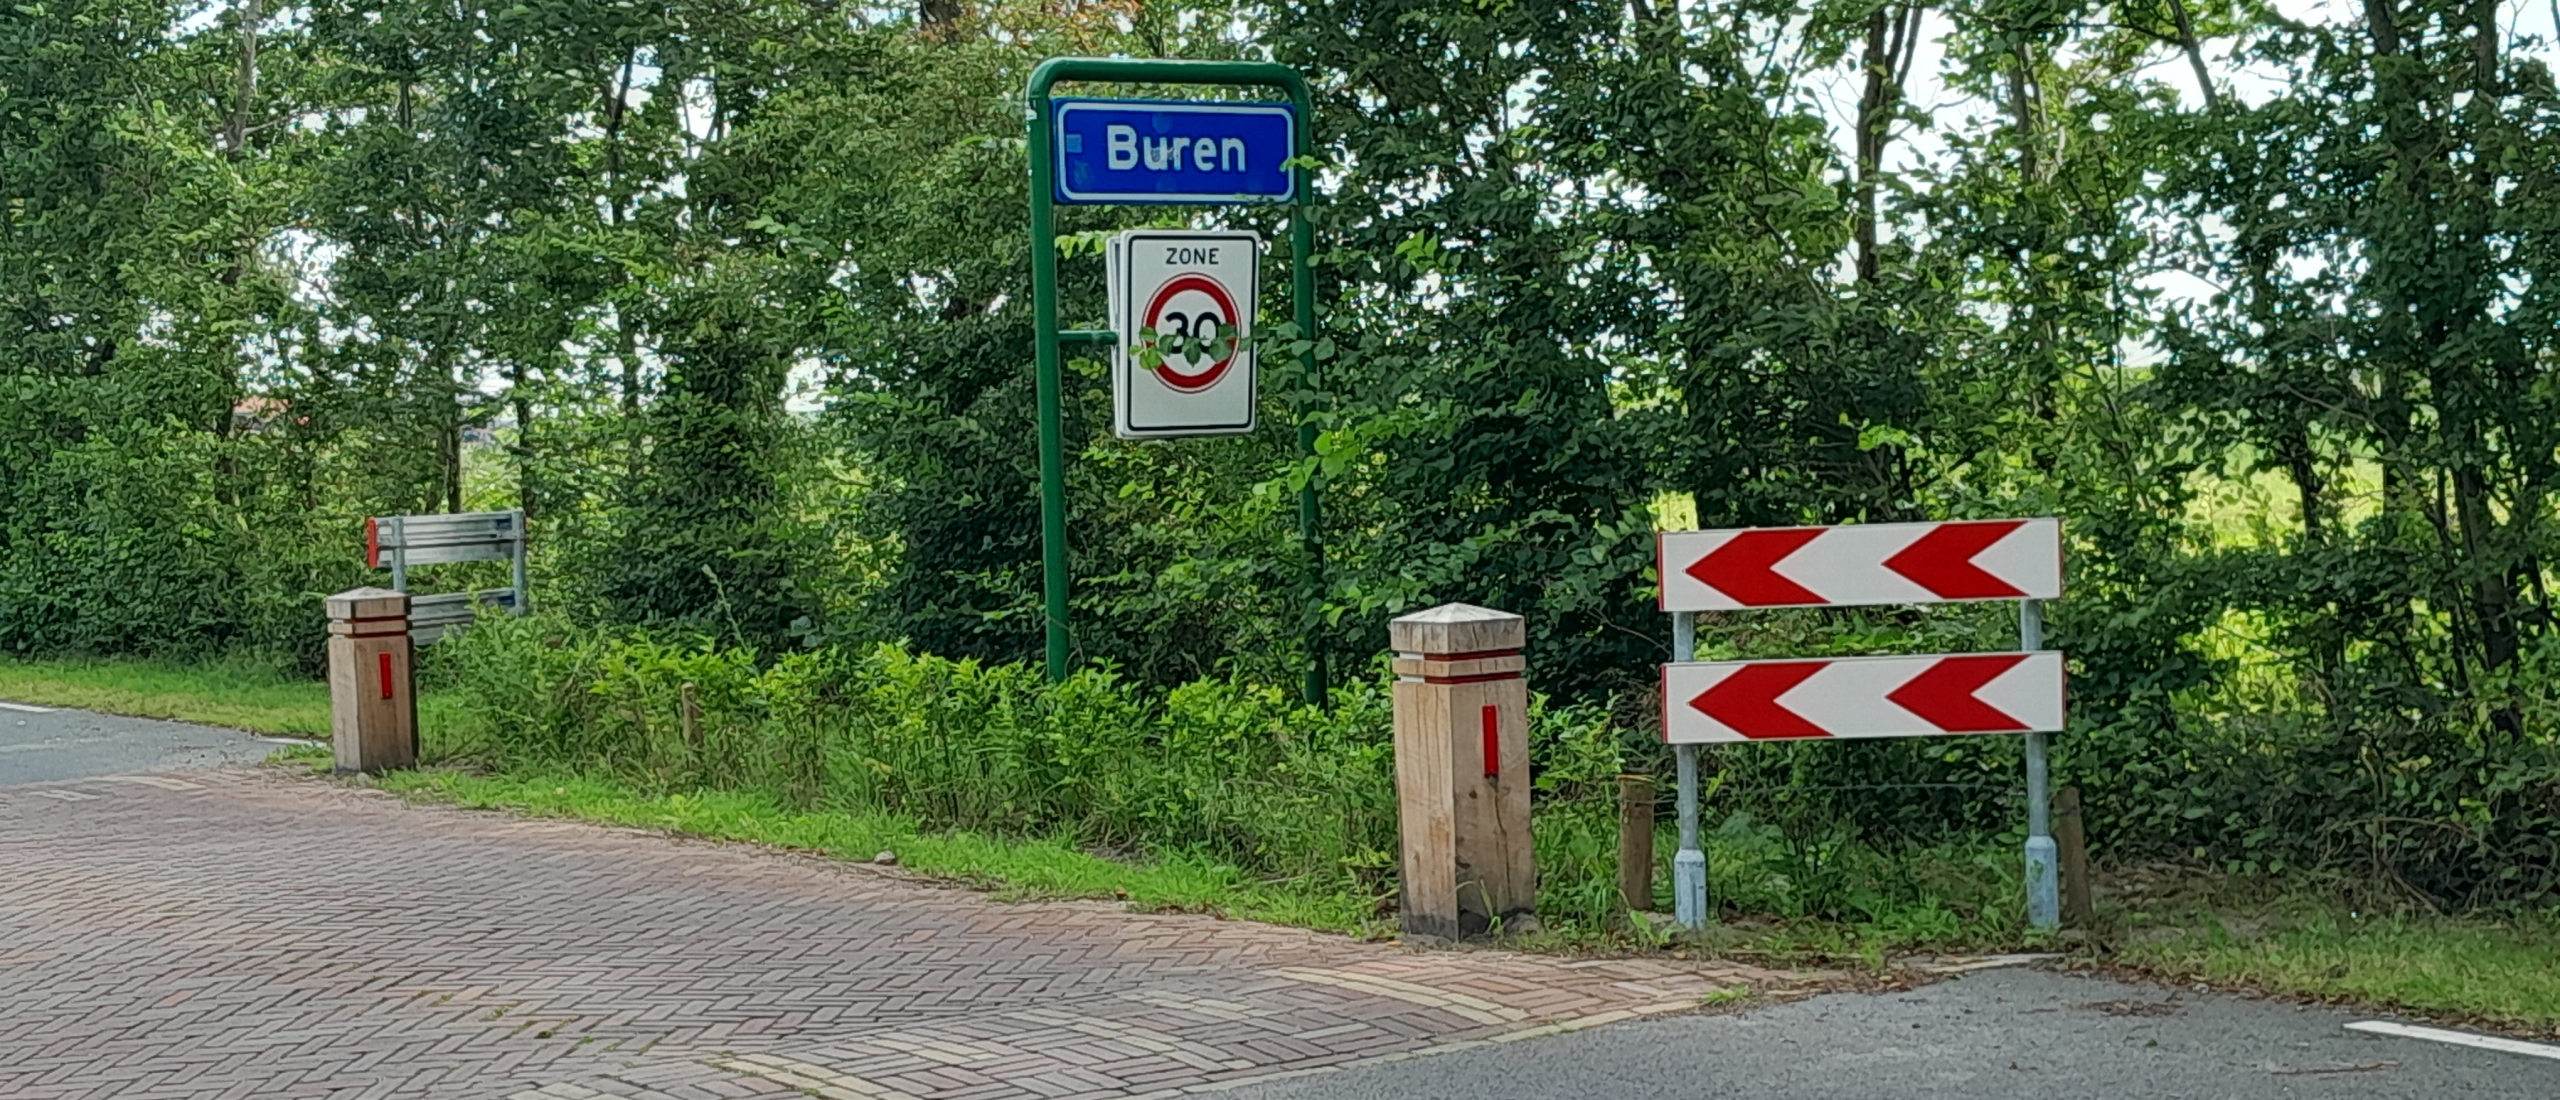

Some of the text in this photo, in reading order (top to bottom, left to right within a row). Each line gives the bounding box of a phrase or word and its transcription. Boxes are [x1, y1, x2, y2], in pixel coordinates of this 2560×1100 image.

[1106, 124, 1247, 173] Buren
[1165, 247, 1220, 265] ZONE
[1165, 311, 1222, 354] 30
